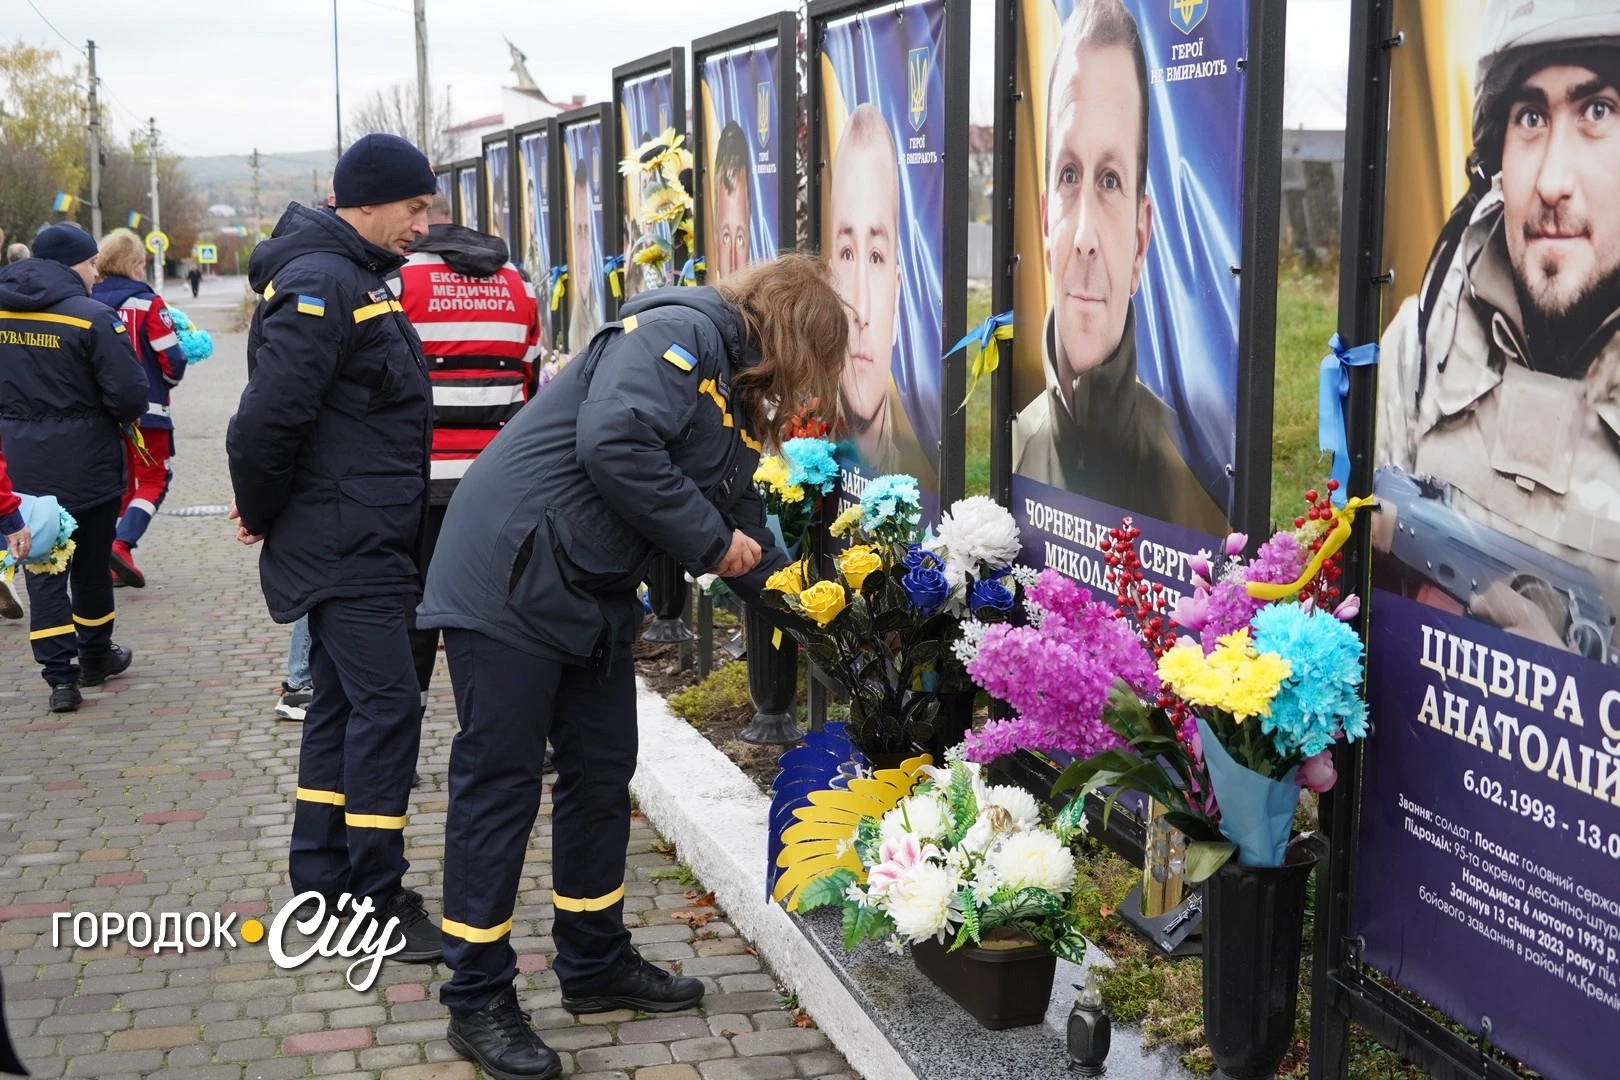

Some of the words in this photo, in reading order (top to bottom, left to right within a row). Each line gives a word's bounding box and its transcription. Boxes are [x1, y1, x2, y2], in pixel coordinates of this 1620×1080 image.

[1150, 68, 1164, 84] НЕ
[1166, 59, 1227, 82] ВМИРАЮТЬ
[1172, 37, 1203, 60] ГЕРОЇ
[428, 298, 515, 312] ДОПОМОГА
[432, 285, 511, 298] МЕДИЧНА
[1025, 498, 1135, 558] ЧОРНЕНЬК
[1463, 769, 1556, 829] 6.02.1993
[1398, 793, 1433, 823] Звання:
[1434, 815, 1472, 843] солдат.
[1475, 831, 1519, 866] Посада:
[1522, 857, 1574, 894] головний
[1404, 816, 1452, 853] Підрозділ:
[1454, 842, 1480, 868] 95-та
[1481, 860, 1525, 891] окрема
[1419, 885, 1465, 923] бойового
[1467, 915, 1515, 951] завдання
[1517, 943, 1523, 955] в
[1525, 947, 1565, 980] районі
[1450, 881, 1490, 916] Загинув
[1493, 905, 1505, 924] 13
[1507, 916, 1536, 941] січня
[1537, 930, 1564, 957] 2023
[1566, 948, 1597, 976] року
[1598, 965, 1616, 987] під
[1462, 867, 1521, 911] Народився
[1523, 900, 1529, 915] 6
[1532, 908, 1574, 939] лютого
[1577, 927, 1605, 956] 1993
[1607, 946, 1620, 964] р.
